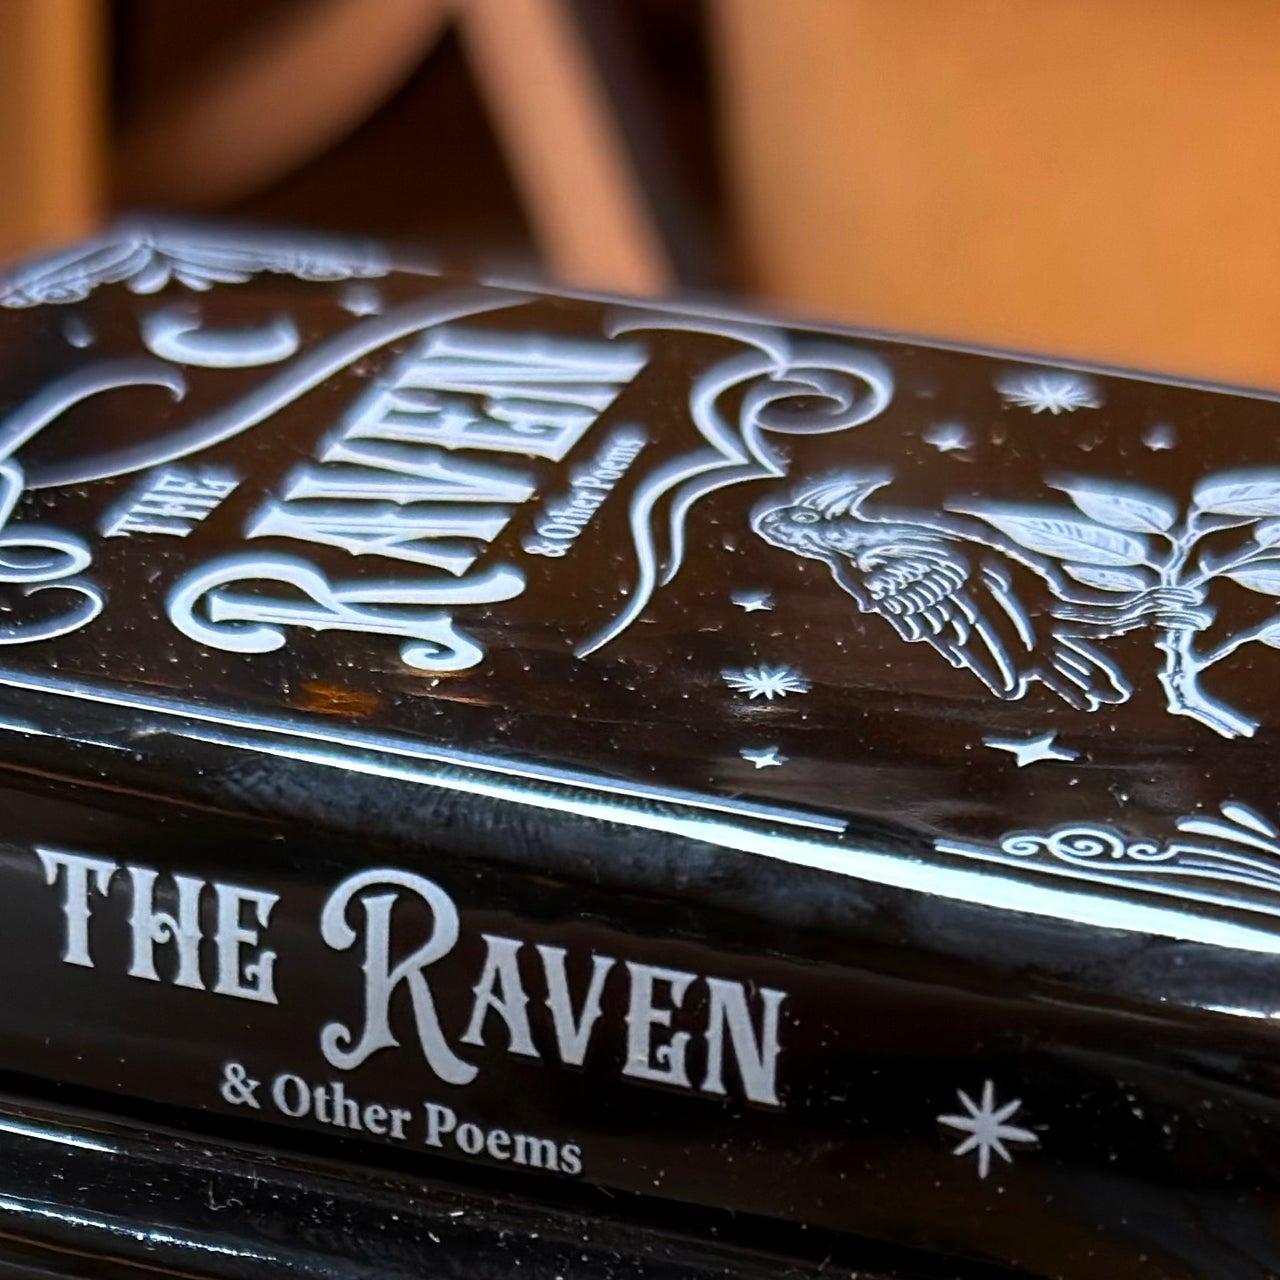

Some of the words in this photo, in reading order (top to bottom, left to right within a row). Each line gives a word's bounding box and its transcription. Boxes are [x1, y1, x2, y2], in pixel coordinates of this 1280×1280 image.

[571, 435, 648, 491] Poems
[103, 466, 241, 538] THE
[167, 327, 648, 672] RAVEN
[536, 490, 608, 540] Other
[523, 538, 572, 558] &
[35, 847, 281, 1005] THE
[320, 868, 788, 1108] RAVEN
[221, 1062, 261, 1110] &
[271, 1073, 412, 1142] Other
[424, 1101, 583, 1177] Poems
